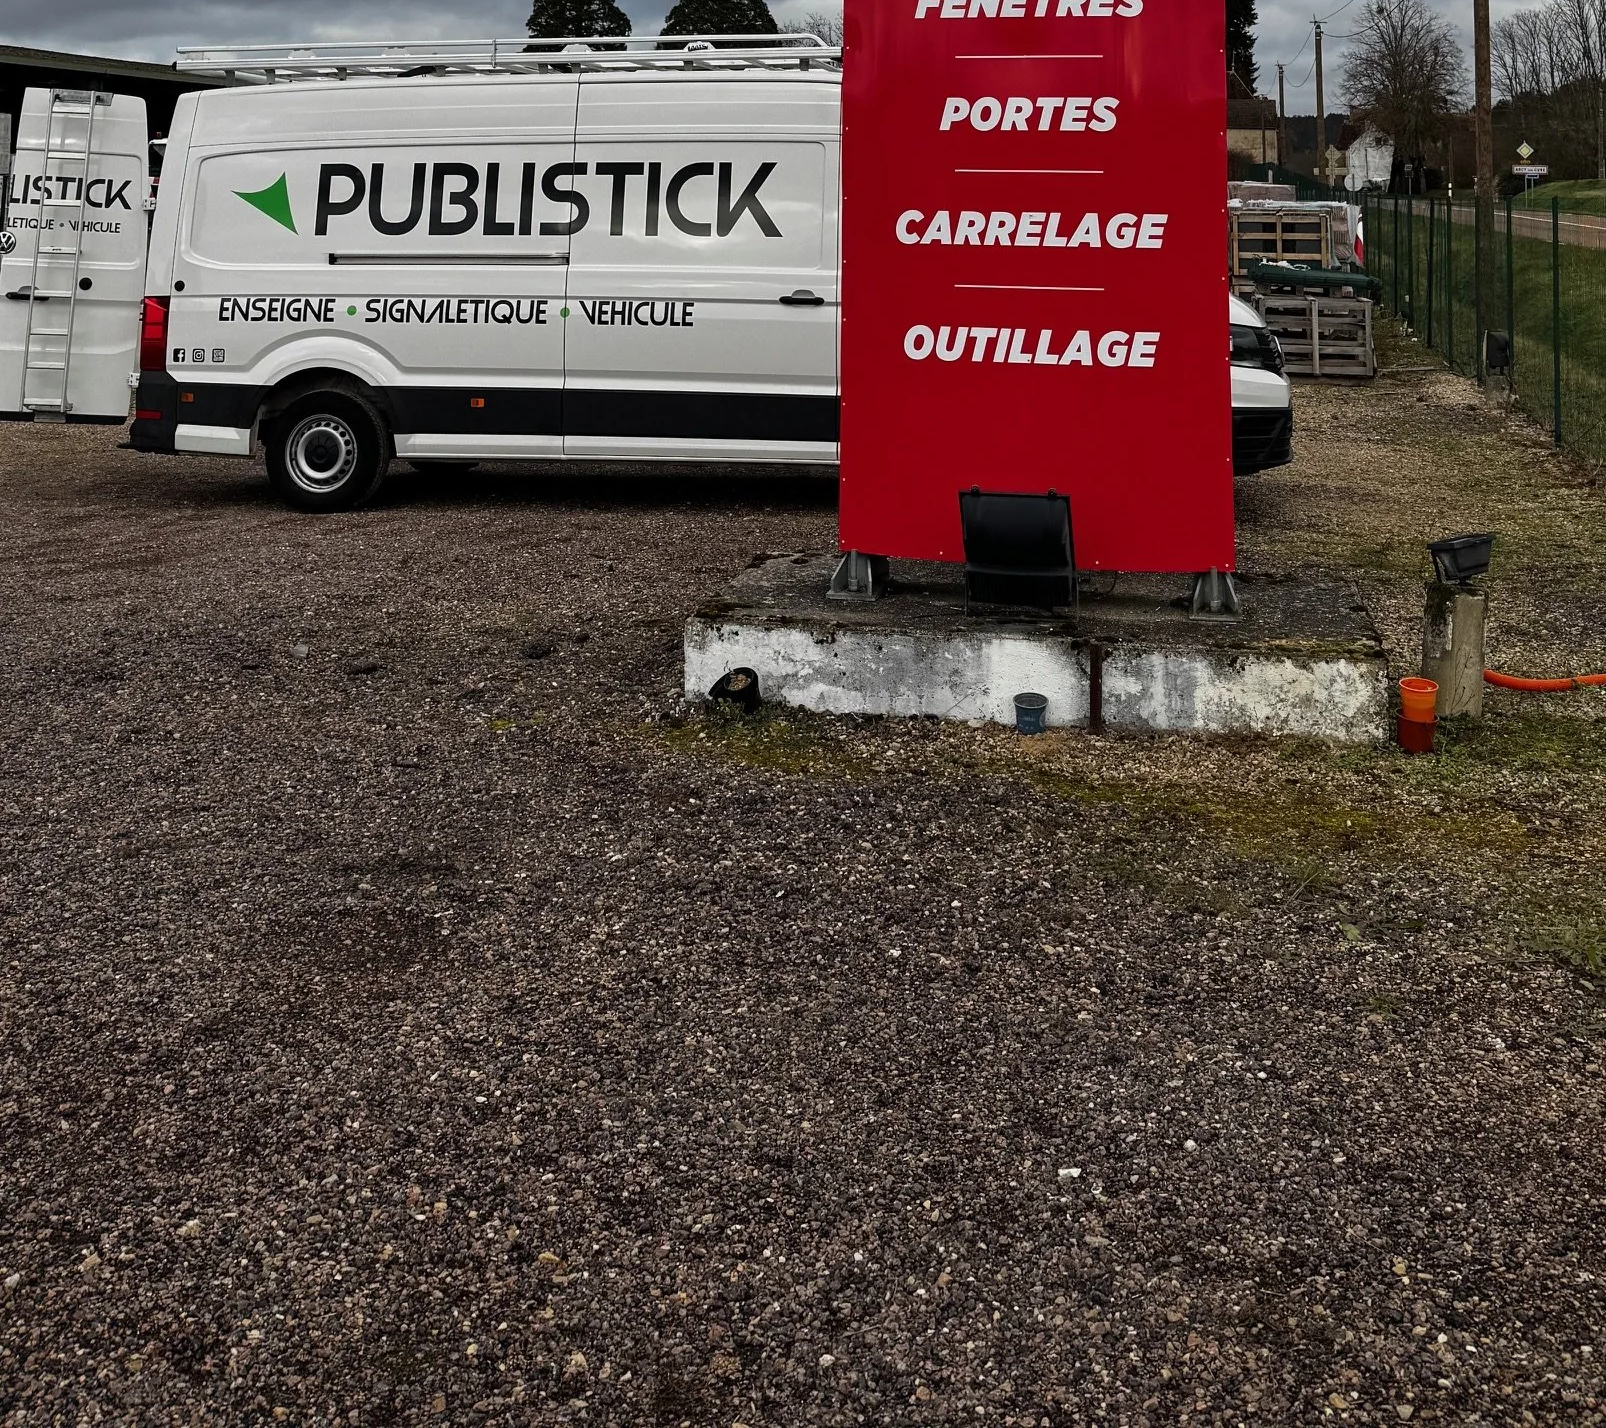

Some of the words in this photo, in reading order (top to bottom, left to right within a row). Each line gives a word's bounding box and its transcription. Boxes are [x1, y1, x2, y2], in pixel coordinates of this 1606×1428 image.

[939, 96, 1120, 132] PORTES
[315, 162, 784, 238] PUBLISTICK
[895, 209, 1169, 249] CARRELAGE
[218, 298, 336, 322] ENSEIGNE
[364, 298, 548, 325] SIGNALETIQUE
[579, 300, 695, 327] VEHICULE
[903, 325, 1161, 368] OUTILLAGE
